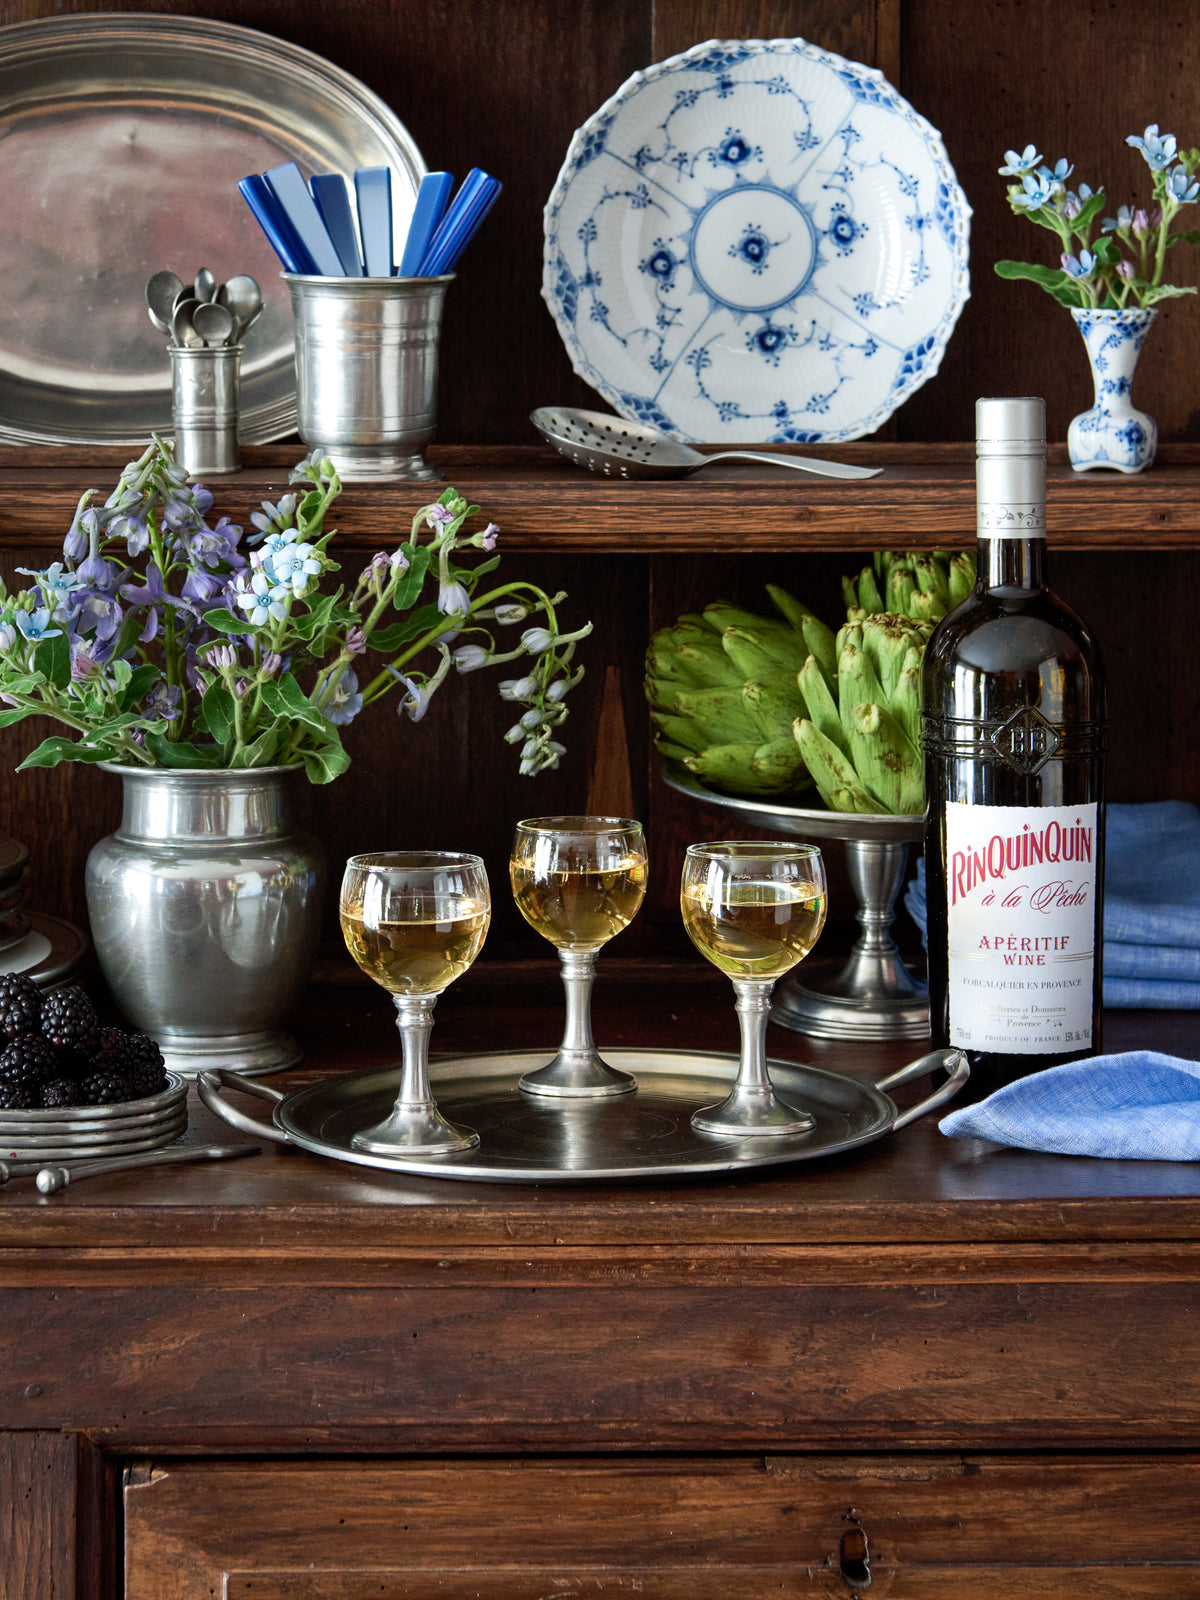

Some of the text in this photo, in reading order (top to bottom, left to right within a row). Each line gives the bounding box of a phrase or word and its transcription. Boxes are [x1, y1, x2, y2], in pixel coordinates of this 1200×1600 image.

[981, 880, 1089, 914] à la Pêche
[978, 933, 1070, 951] APÉRITIF
[1003, 953, 1046, 966] WINE
[963, 977, 1082, 990] FORCALQUIER EN PROVENCE
[1007, 1018, 1041, 1027] Provence
[984, 1034, 1018, 1042] PRODUCT
[1034, 1034, 1060, 1042] FRANCE
